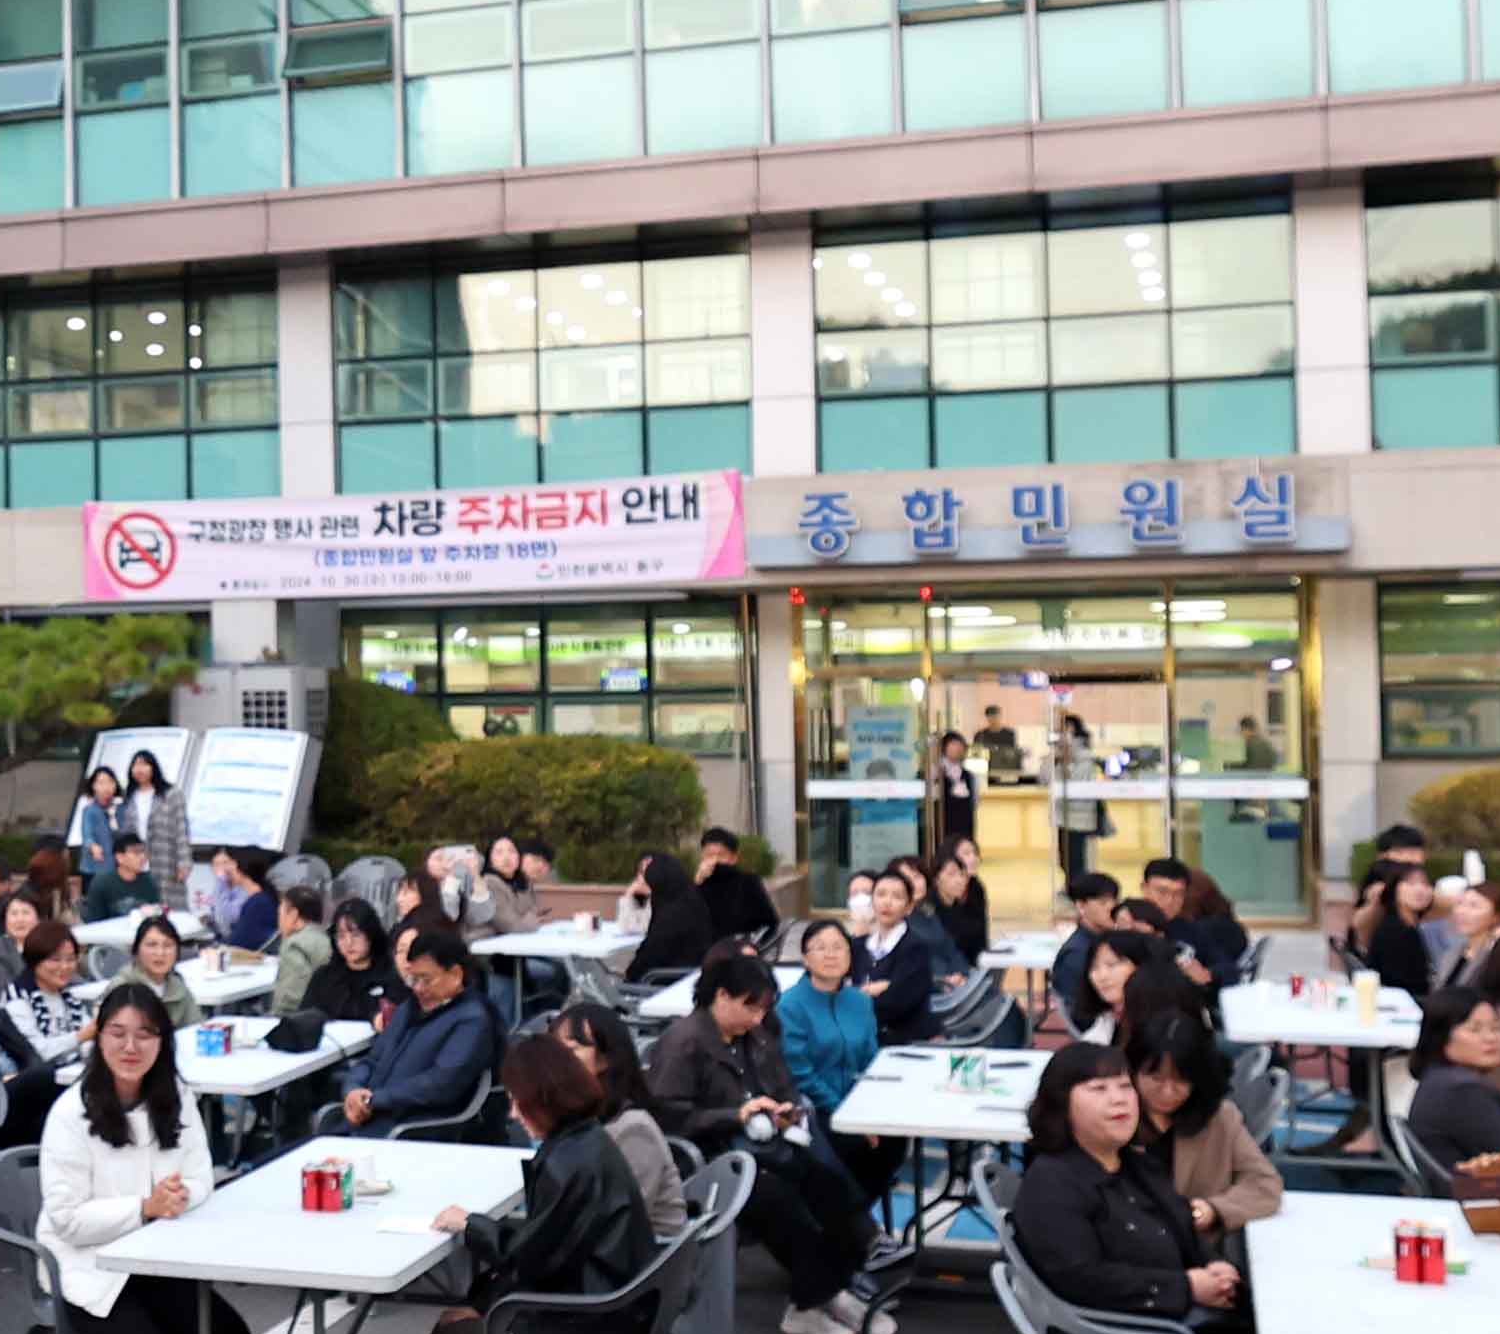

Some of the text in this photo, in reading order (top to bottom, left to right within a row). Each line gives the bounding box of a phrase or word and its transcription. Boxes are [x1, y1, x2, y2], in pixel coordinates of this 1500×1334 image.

[274, 517, 313, 541] 행사
[319, 514, 360, 539] 관련
[373, 497, 447, 538] 차량
[457, 488, 609, 535] 주차금지
[622, 482, 700, 525] 안내
[798, 472, 1298, 558] 종합민원실
